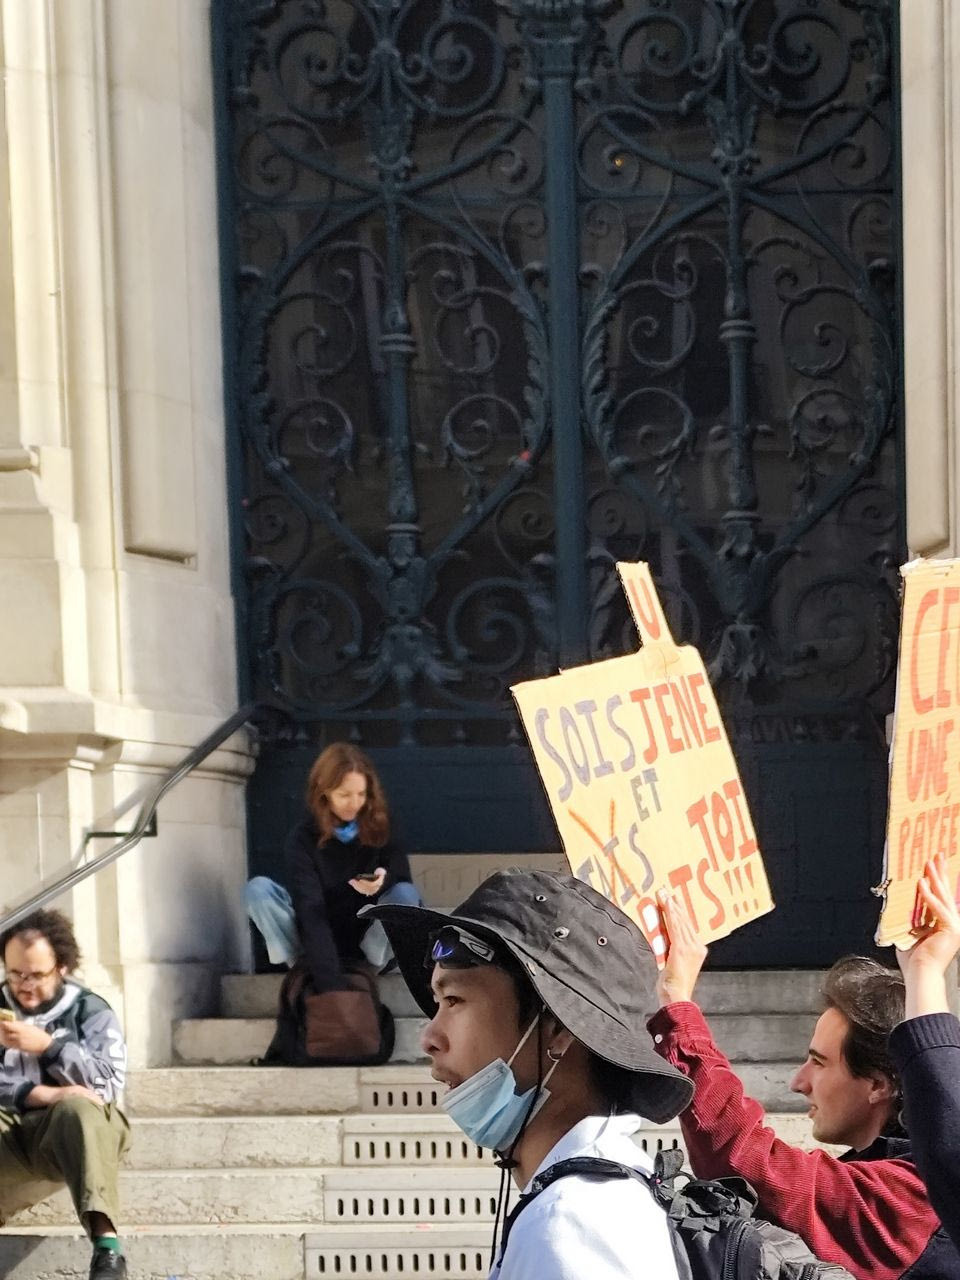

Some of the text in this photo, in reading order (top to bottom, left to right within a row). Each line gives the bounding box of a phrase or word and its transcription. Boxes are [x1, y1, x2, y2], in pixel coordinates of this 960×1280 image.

[628, 577, 661, 640] U
[534, 693, 636, 803] SOIS
[906, 718, 954, 803] UNE
[632, 767, 662, 822] ET
[686, 778, 758, 872] TOI
